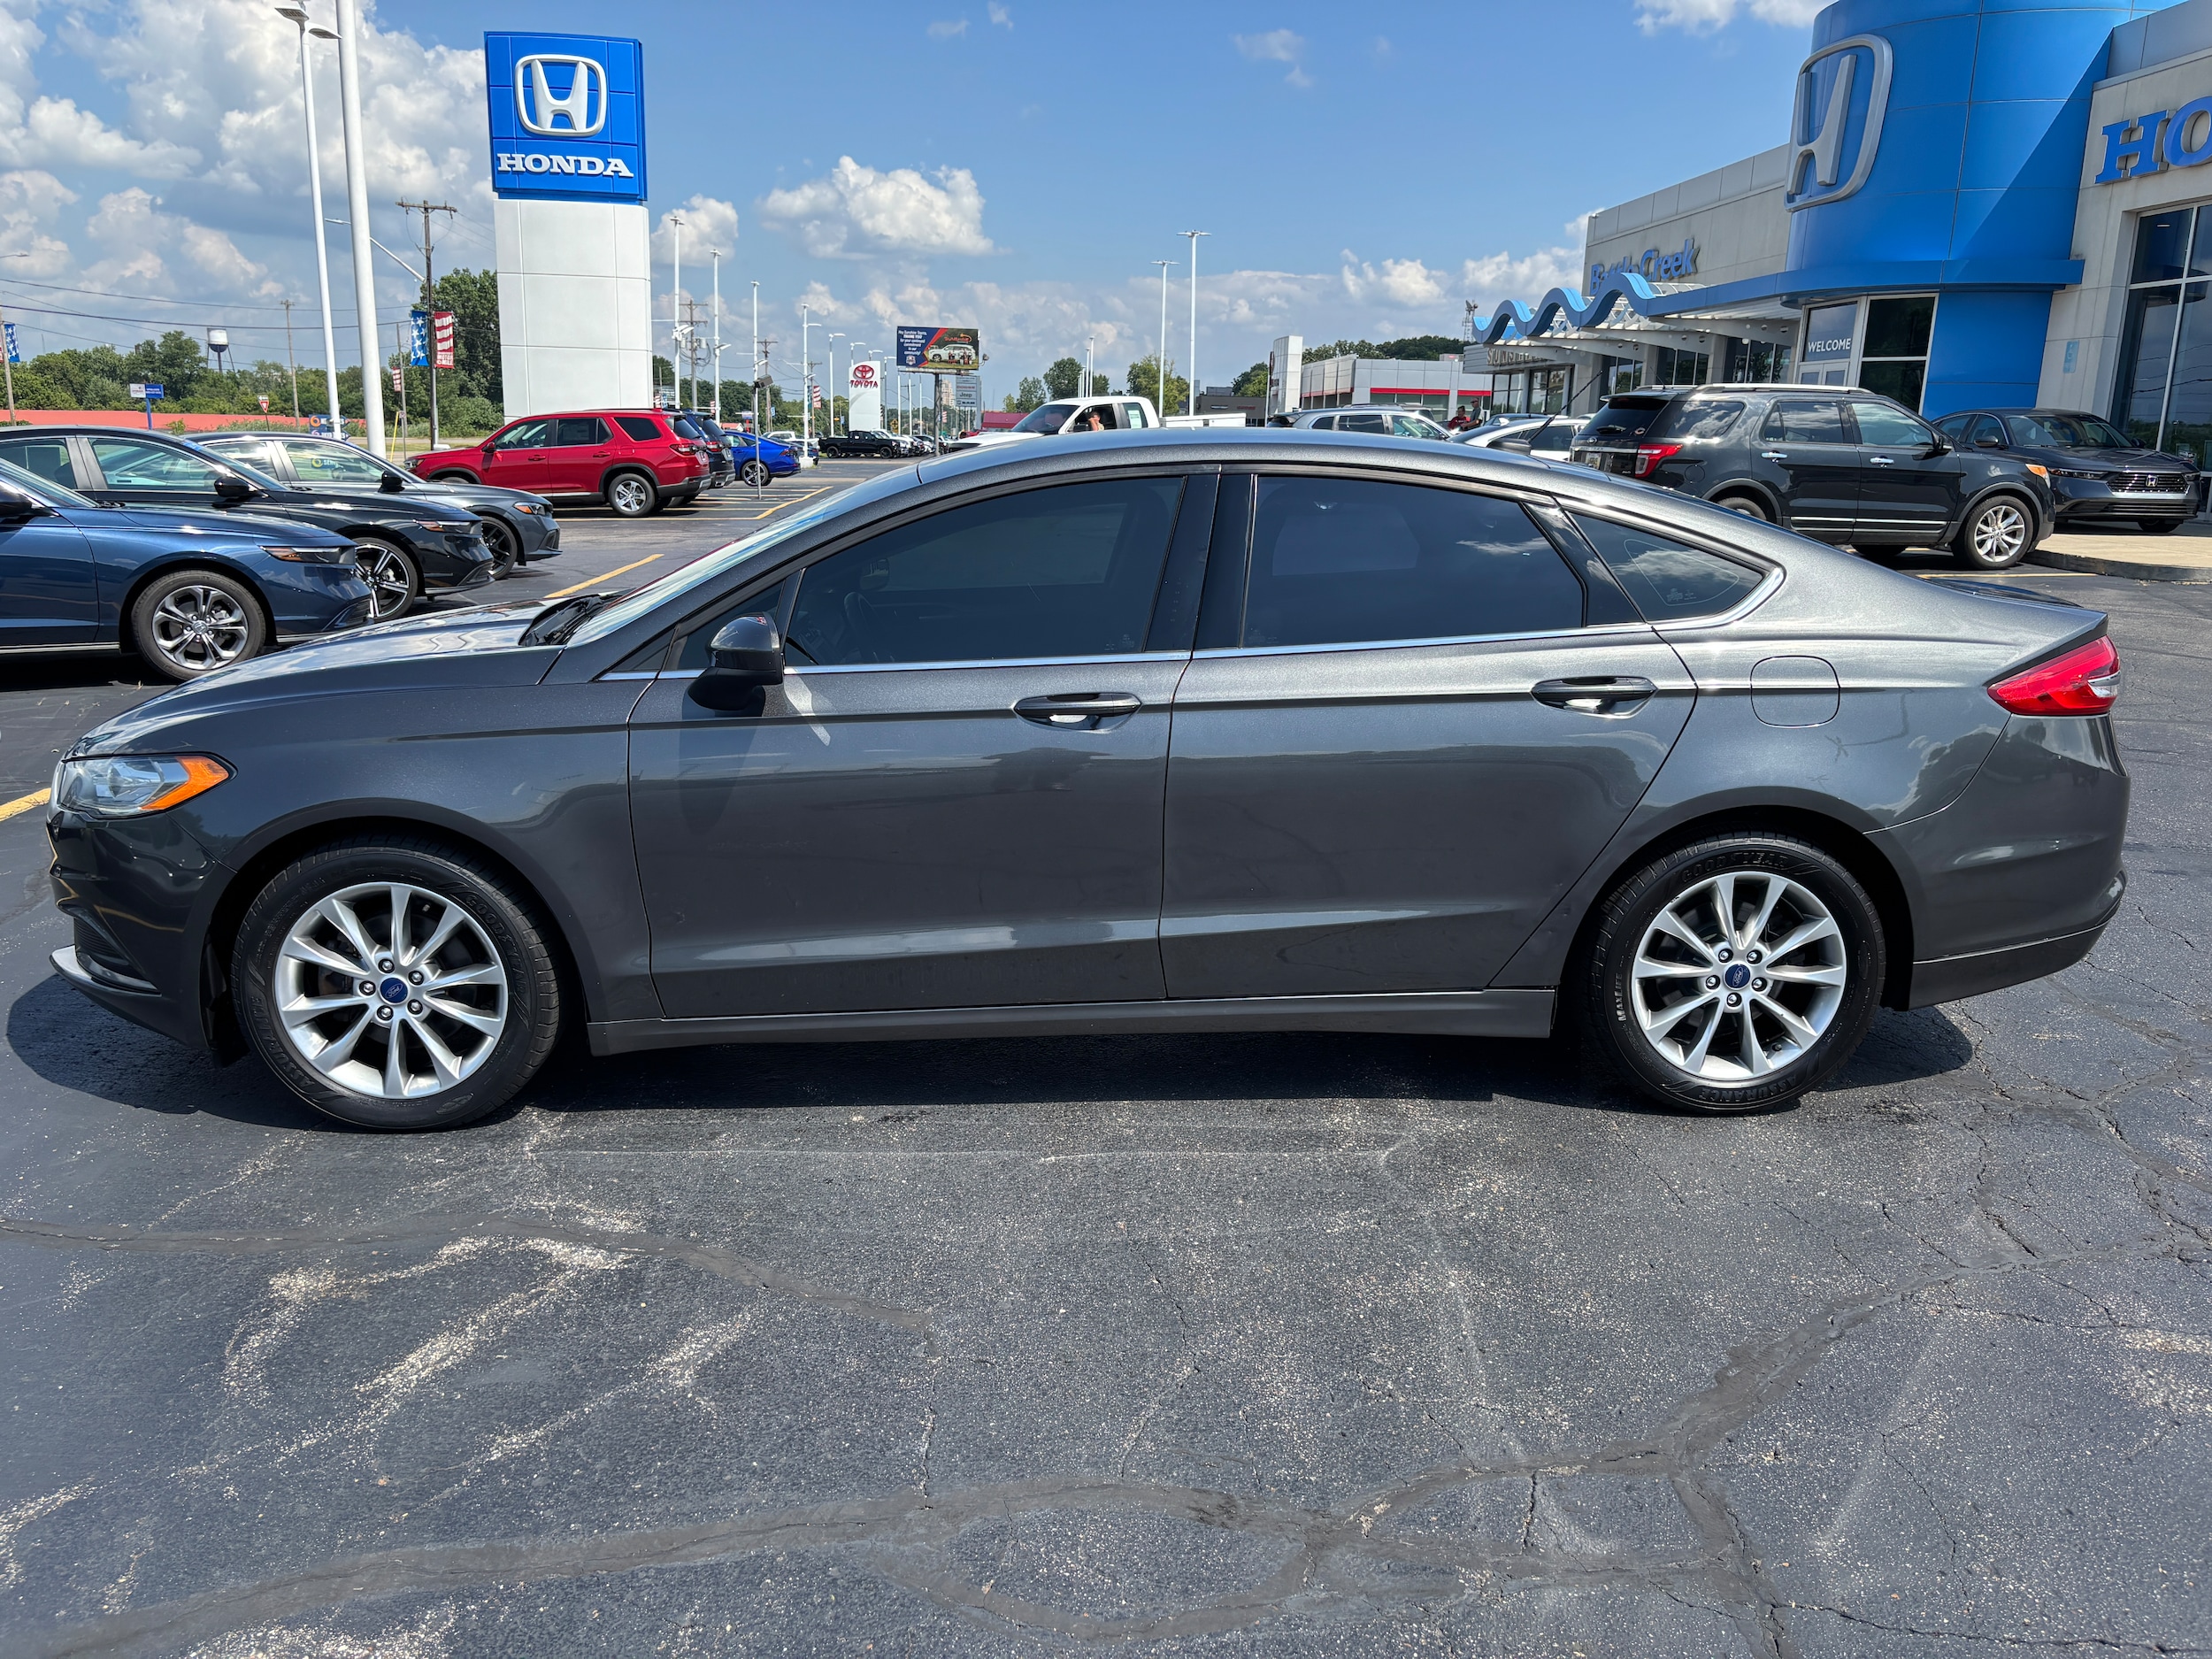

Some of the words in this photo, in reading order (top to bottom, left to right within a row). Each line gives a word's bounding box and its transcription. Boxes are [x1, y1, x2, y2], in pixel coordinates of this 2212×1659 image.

[497, 153, 634, 178] HONDA
[1640, 238, 1694, 282] Creek
[1808, 338, 1851, 353] WELCOME
[1614, 972, 1627, 1022] MAXLIFE
